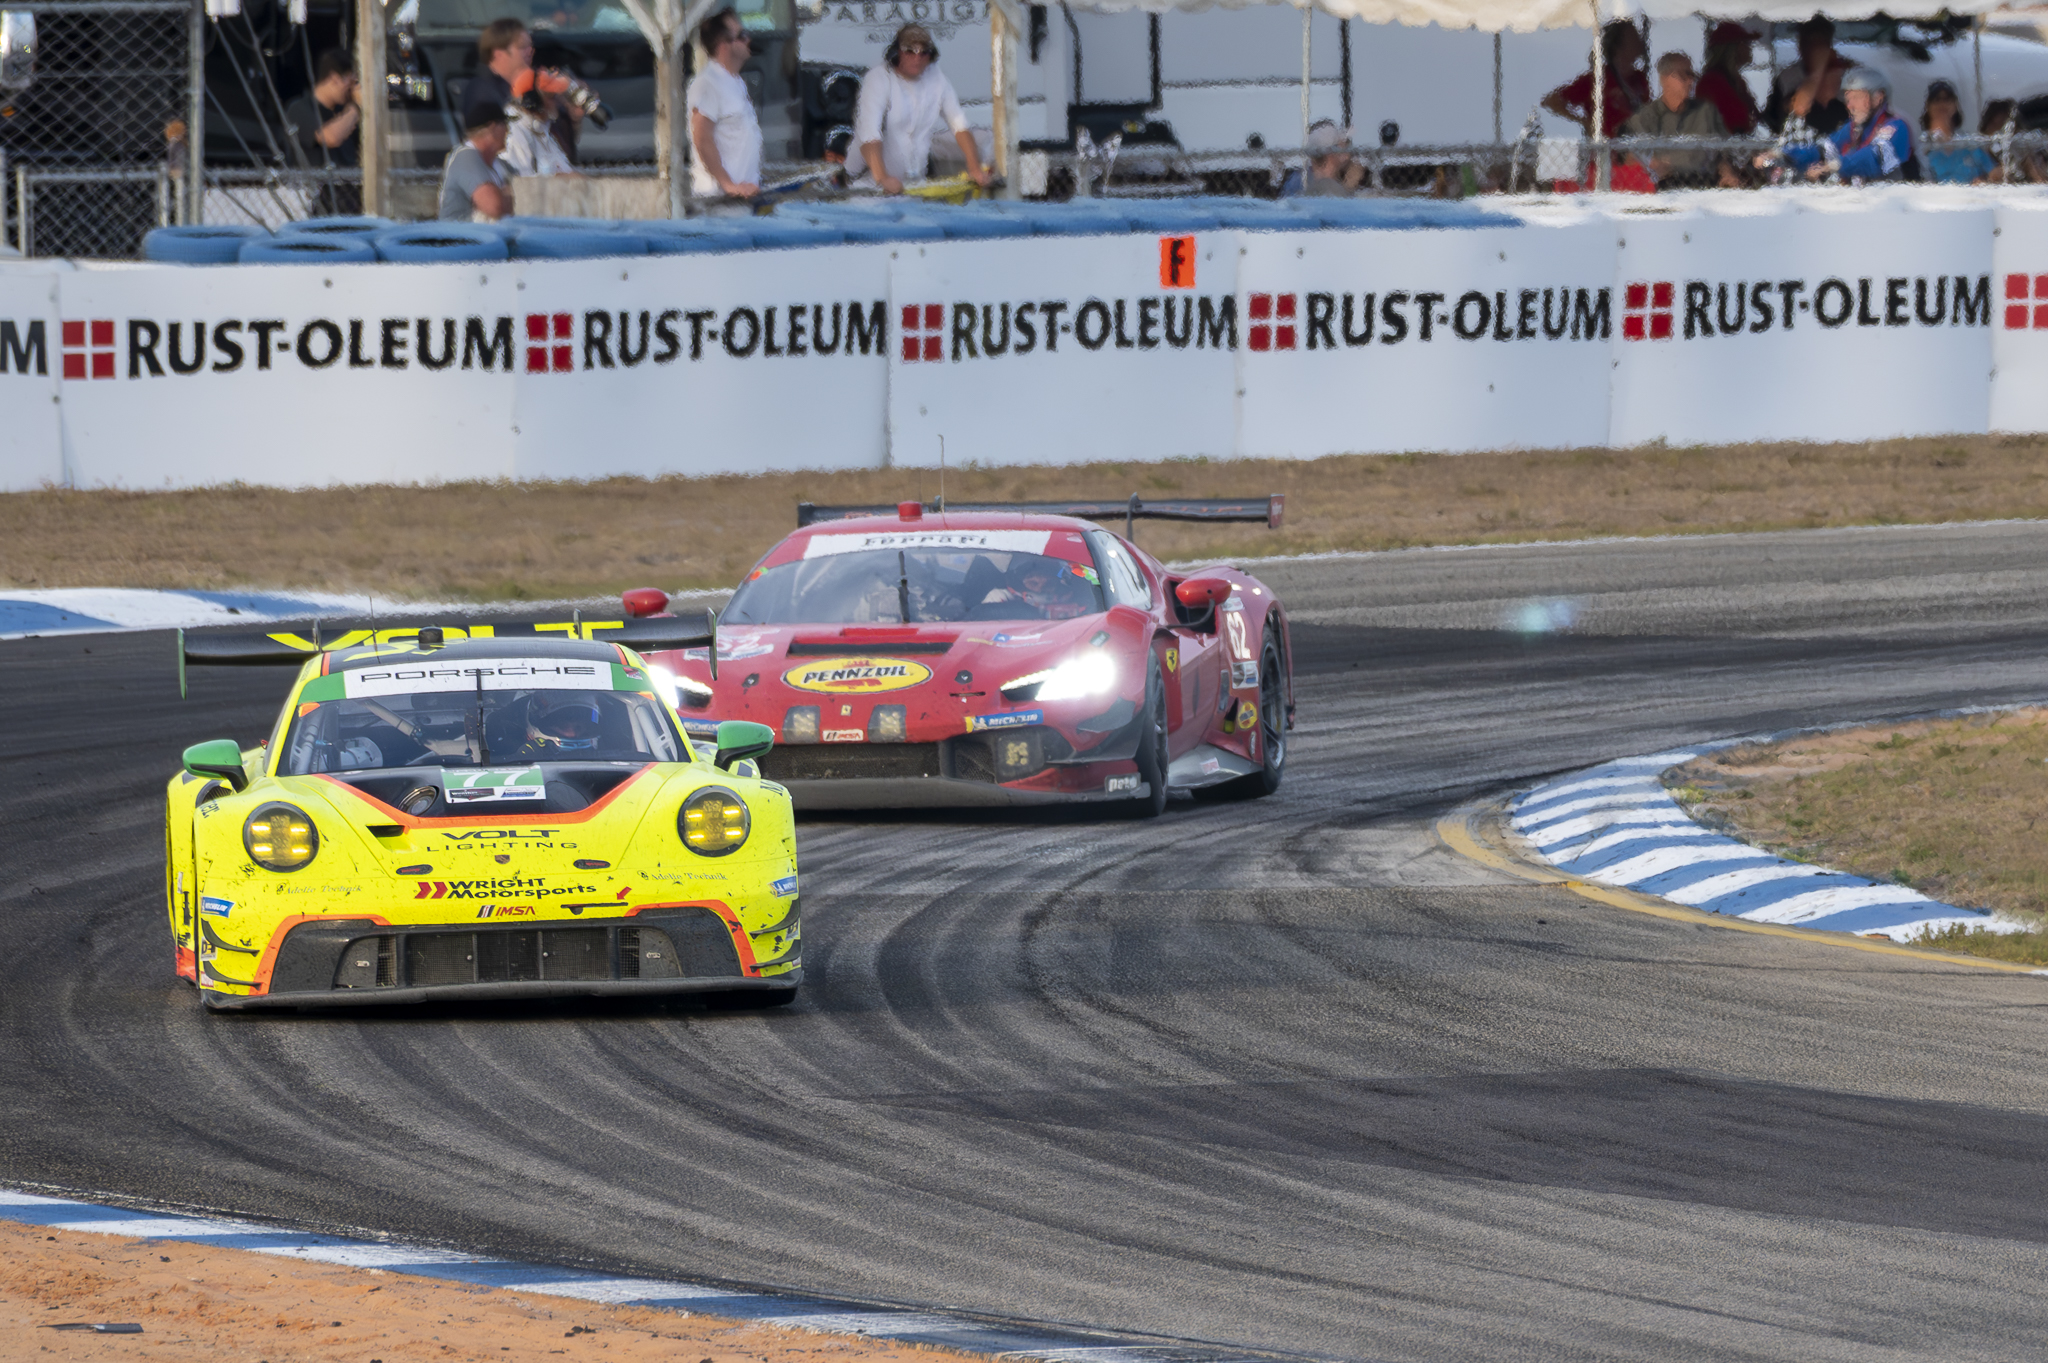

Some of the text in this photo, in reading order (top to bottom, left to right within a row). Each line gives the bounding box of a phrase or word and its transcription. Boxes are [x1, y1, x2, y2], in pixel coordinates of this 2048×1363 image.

[1168, 238, 1187, 286] F
[1683, 275, 1991, 340] RUST-OLEUM
[952, 295, 1238, 362] RUST-OLEUM
[1305, 288, 1612, 351] RUST-OLEUM
[583, 301, 888, 370] RUST-OLEUM
[128, 317, 514, 379] RUST-OLEUM
[863, 532, 987, 547] Ferrari
[1226, 611, 1251, 660] 62
[361, 666, 596, 683] PORSCHE
[803, 665, 910, 684] PENNZOIL
[453, 769, 530, 788] 77
[441, 829, 560, 841] VOLT
[426, 842, 578, 852] LIGHTING
[447, 885, 597, 900] Motorsports
[495, 905, 536, 917] IMSA
